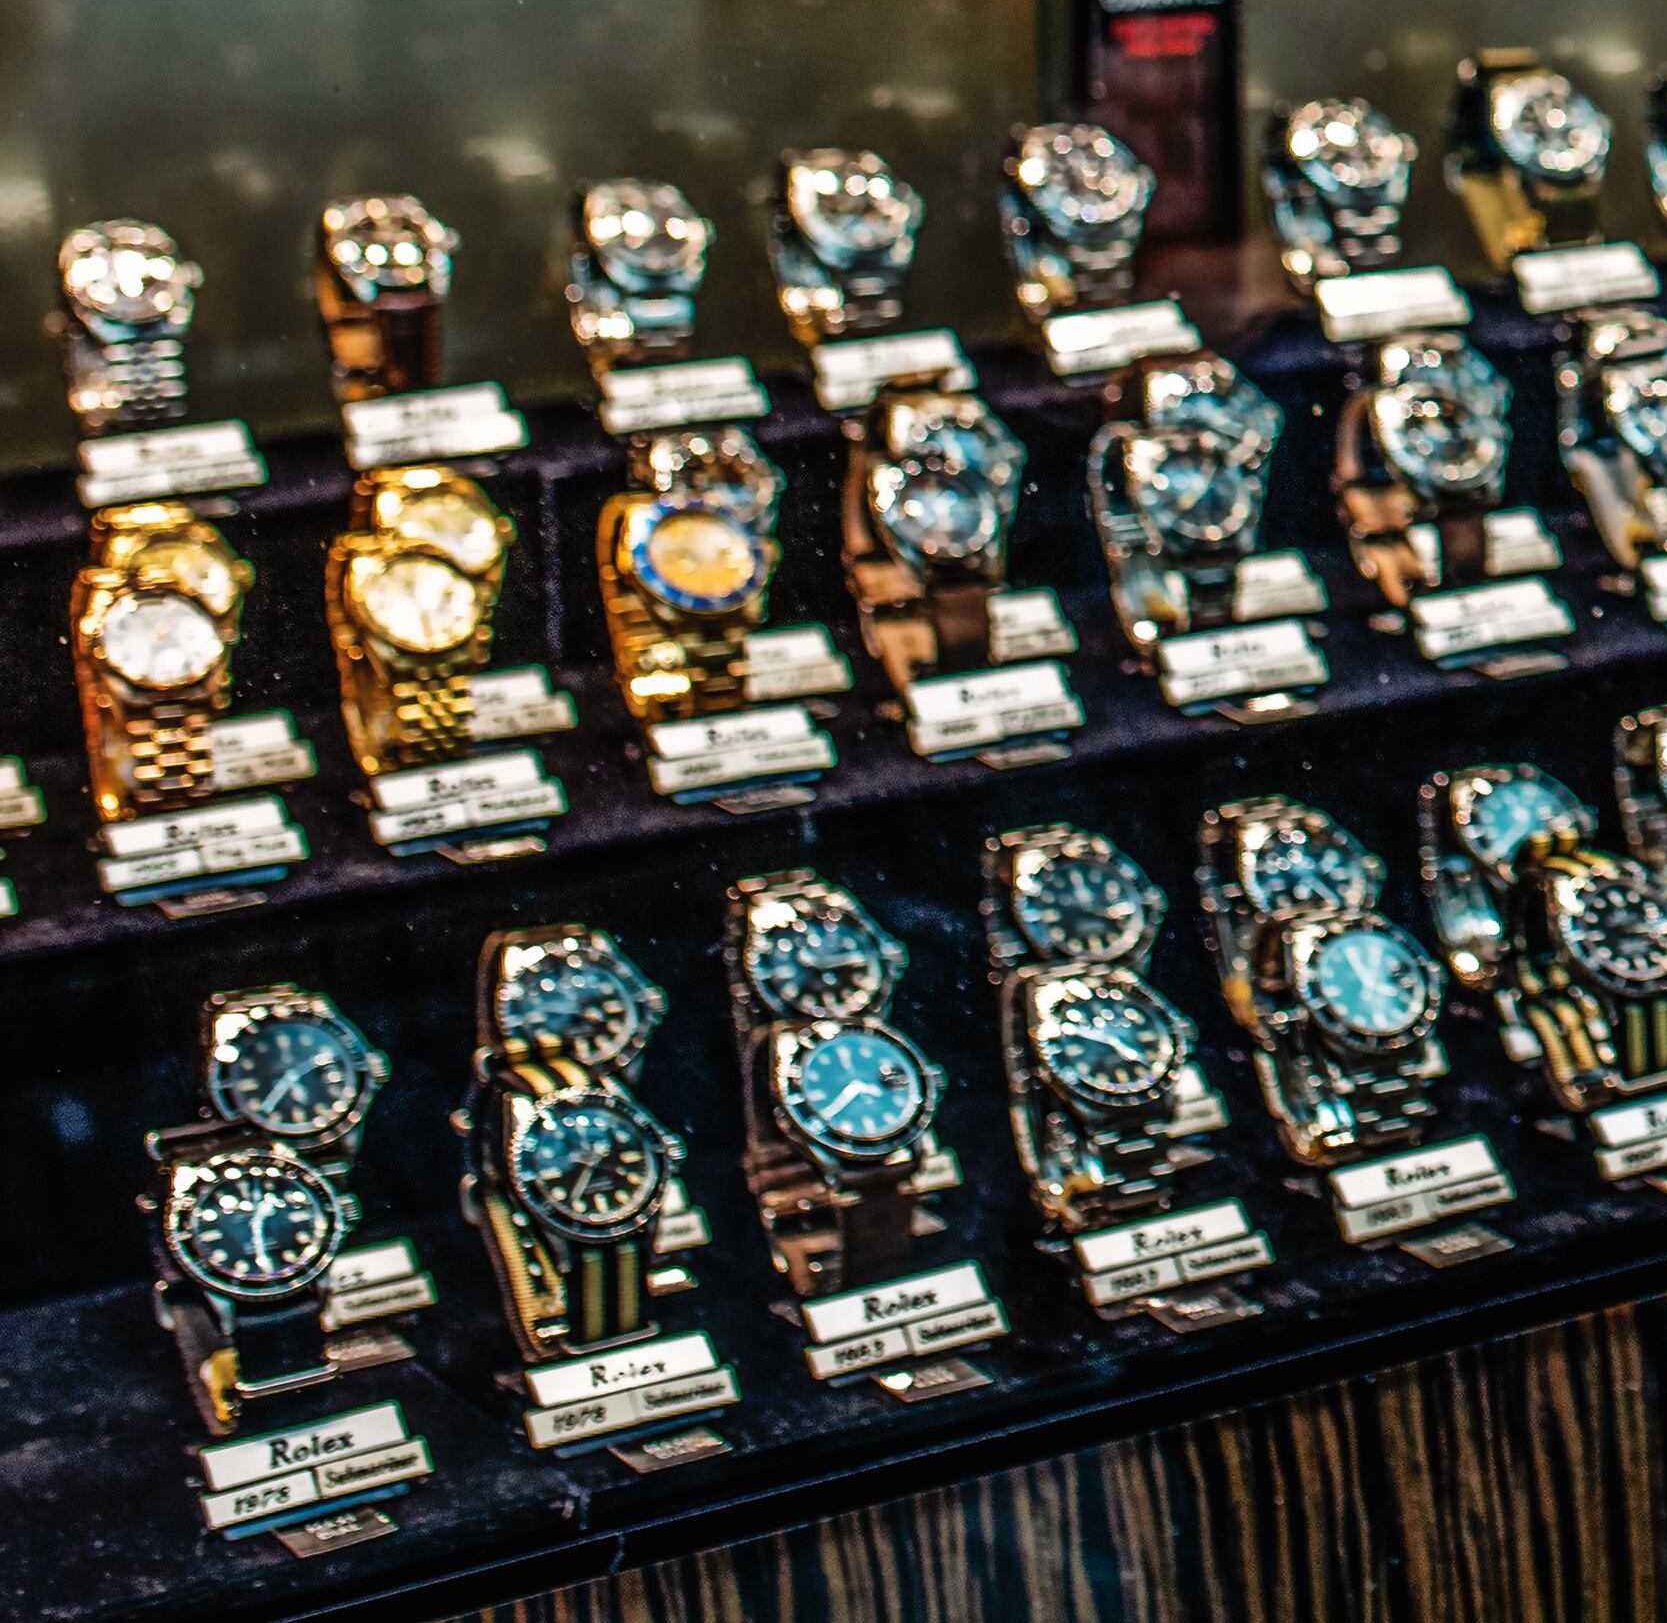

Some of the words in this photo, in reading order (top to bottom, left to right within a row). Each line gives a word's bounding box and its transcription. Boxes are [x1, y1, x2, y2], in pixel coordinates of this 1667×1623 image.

[863, 1289, 939, 1323] Rolex
[268, 1431, 355, 1470] Rolex
[232, 1483, 292, 1516] 1978
